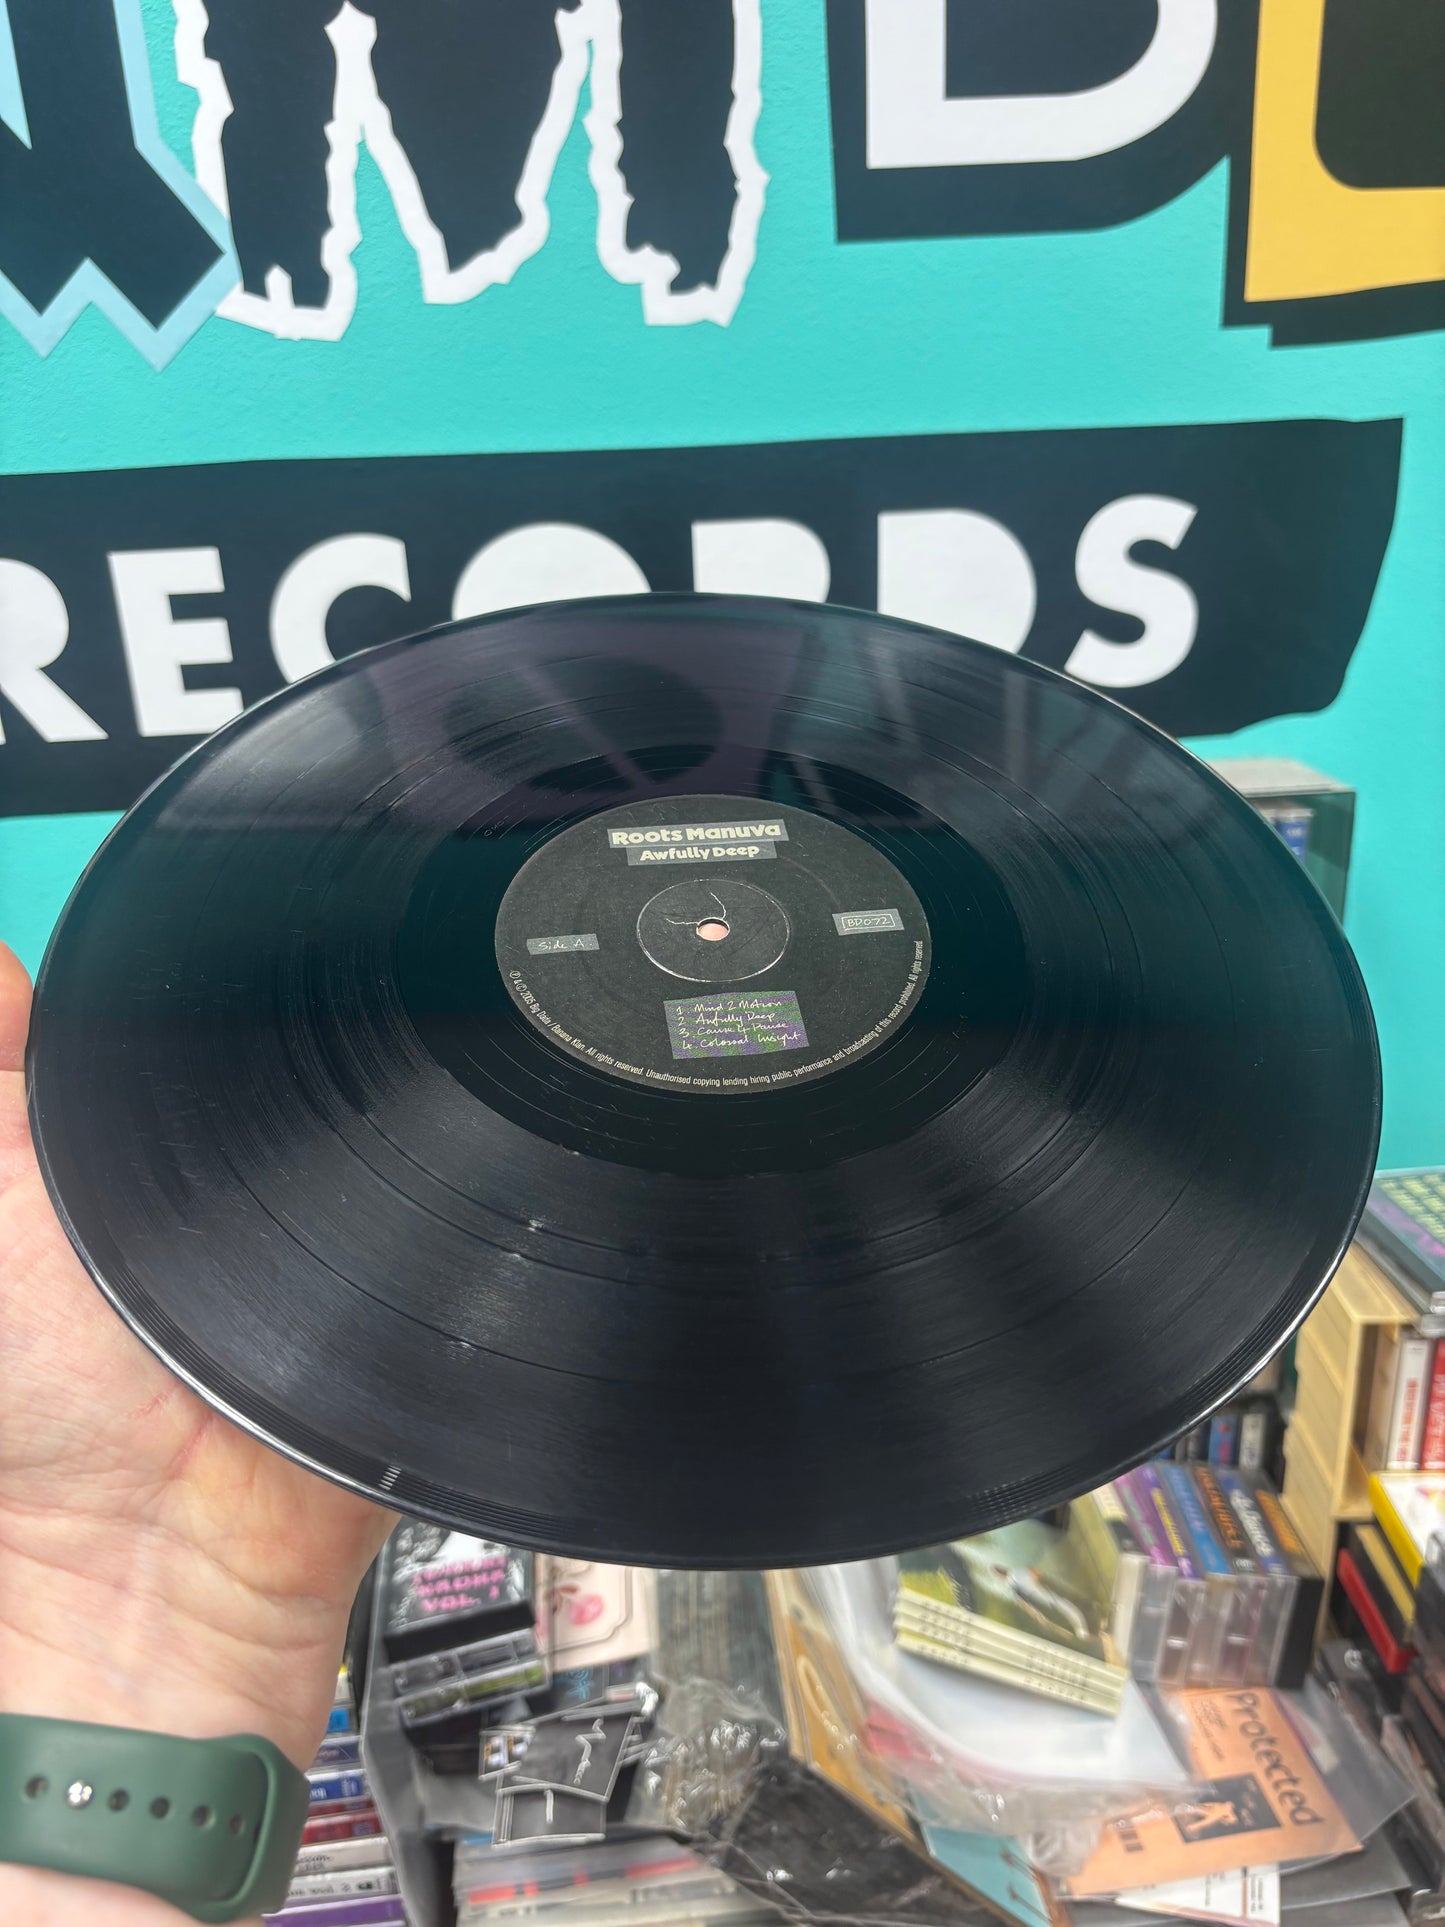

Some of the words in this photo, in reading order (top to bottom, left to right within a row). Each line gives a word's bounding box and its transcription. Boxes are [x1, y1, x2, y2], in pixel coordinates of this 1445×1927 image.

[611, 828, 683, 845] Roots
[685, 824, 782, 841] Manuva
[640, 846, 711, 861] Awfully
[712, 845, 760, 858] Deep
[538, 940, 568, 951] Side
[911, 960, 922, 975] rights
[908, 973, 919, 982] All
[520, 990, 536, 1005] 2005
[530, 1002, 540, 1014] Big
[694, 1002, 723, 1012] Mind
[727, 1001, 736, 1011] 2
[739, 999, 782, 1009] Motion
[888, 1003, 904, 1020] record
[536, 1010, 552, 1026] Dada
[696, 1012, 743, 1027] Awfully
[745, 1011, 775, 1022] Deep
[879, 1017, 892, 1028] this
[551, 1024, 573, 1042] Banana
[697, 1026, 735, 1036] Cause
[737, 1025, 750, 1034] 4
[751, 1022, 789, 1032] Pause
[875, 1024, 884, 1033] of
[700, 1035, 749, 1048] Colossal
[758, 1031, 801, 1047] Insight
[842, 1030, 879, 1055] broadcasting
[585, 1047, 597, 1057] All
[595, 1052, 614, 1065] rights
[832, 1050, 846, 1061] and
[613, 1060, 644, 1075] reserved.
[793, 1057, 833, 1078] performance
[646, 1068, 691, 1084] Unauthorised
[693, 1078, 720, 1087] copying
[723, 1077, 748, 1087] lending
[750, 1075, 770, 1084] hiring
[772, 1071, 792, 1083] public
[1226, 1692, 1326, 1826] Protected
